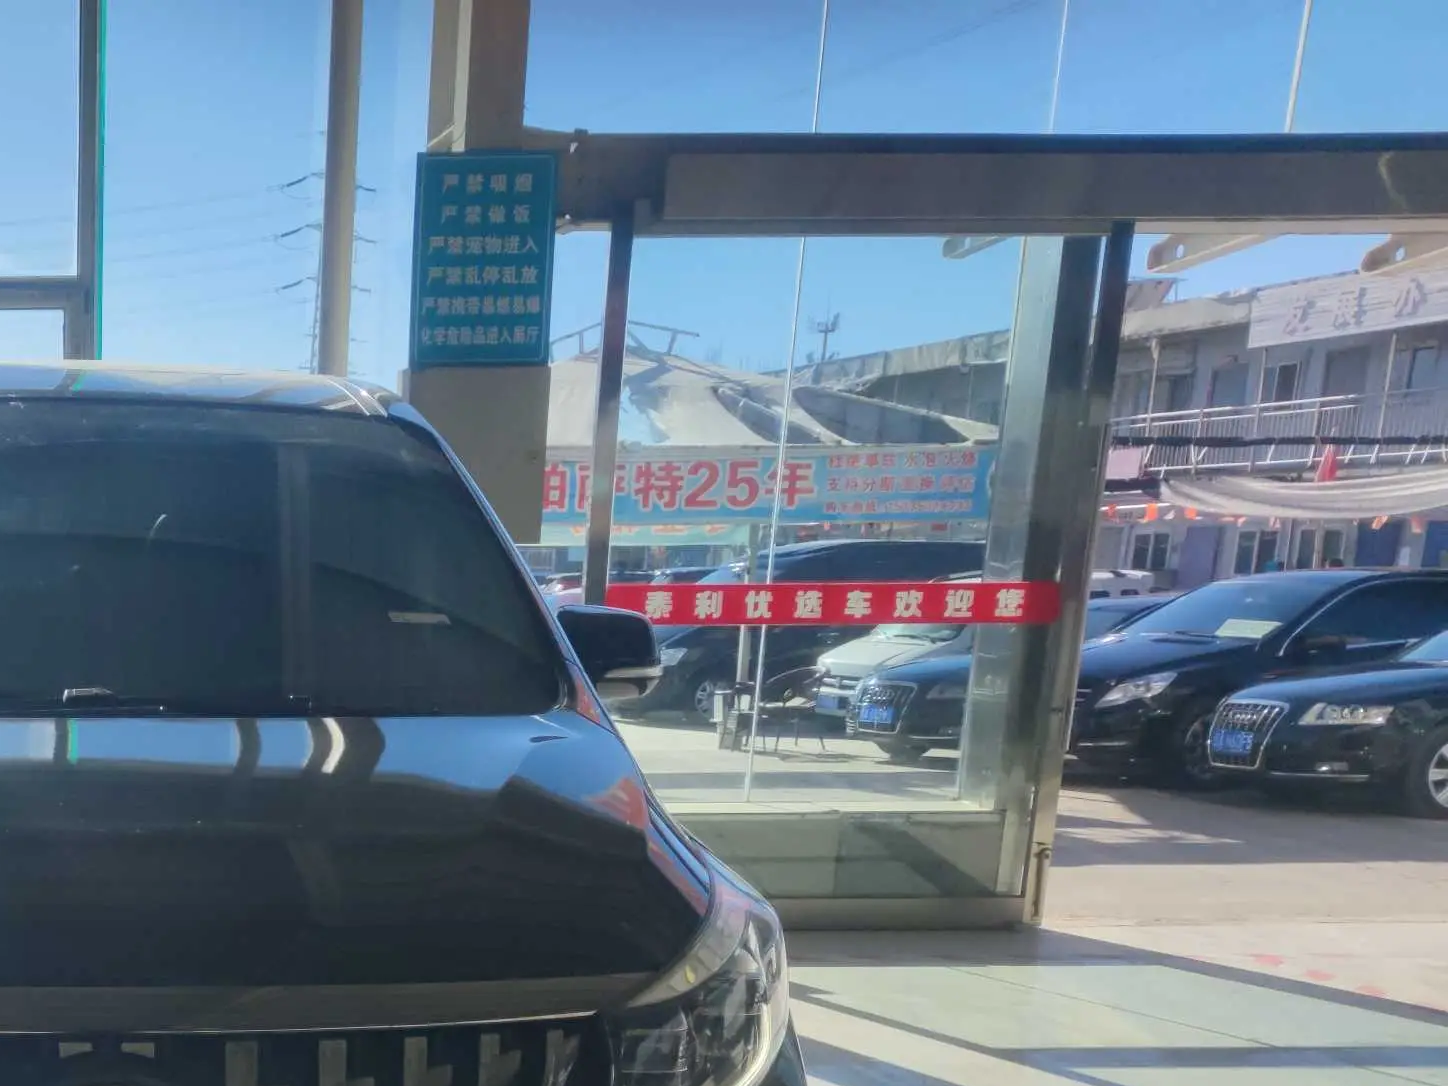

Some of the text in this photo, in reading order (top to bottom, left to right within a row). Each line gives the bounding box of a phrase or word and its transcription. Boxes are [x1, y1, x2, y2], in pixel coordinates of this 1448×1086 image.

[645, 589, 1026, 619] 泰利优选车欢迎您
